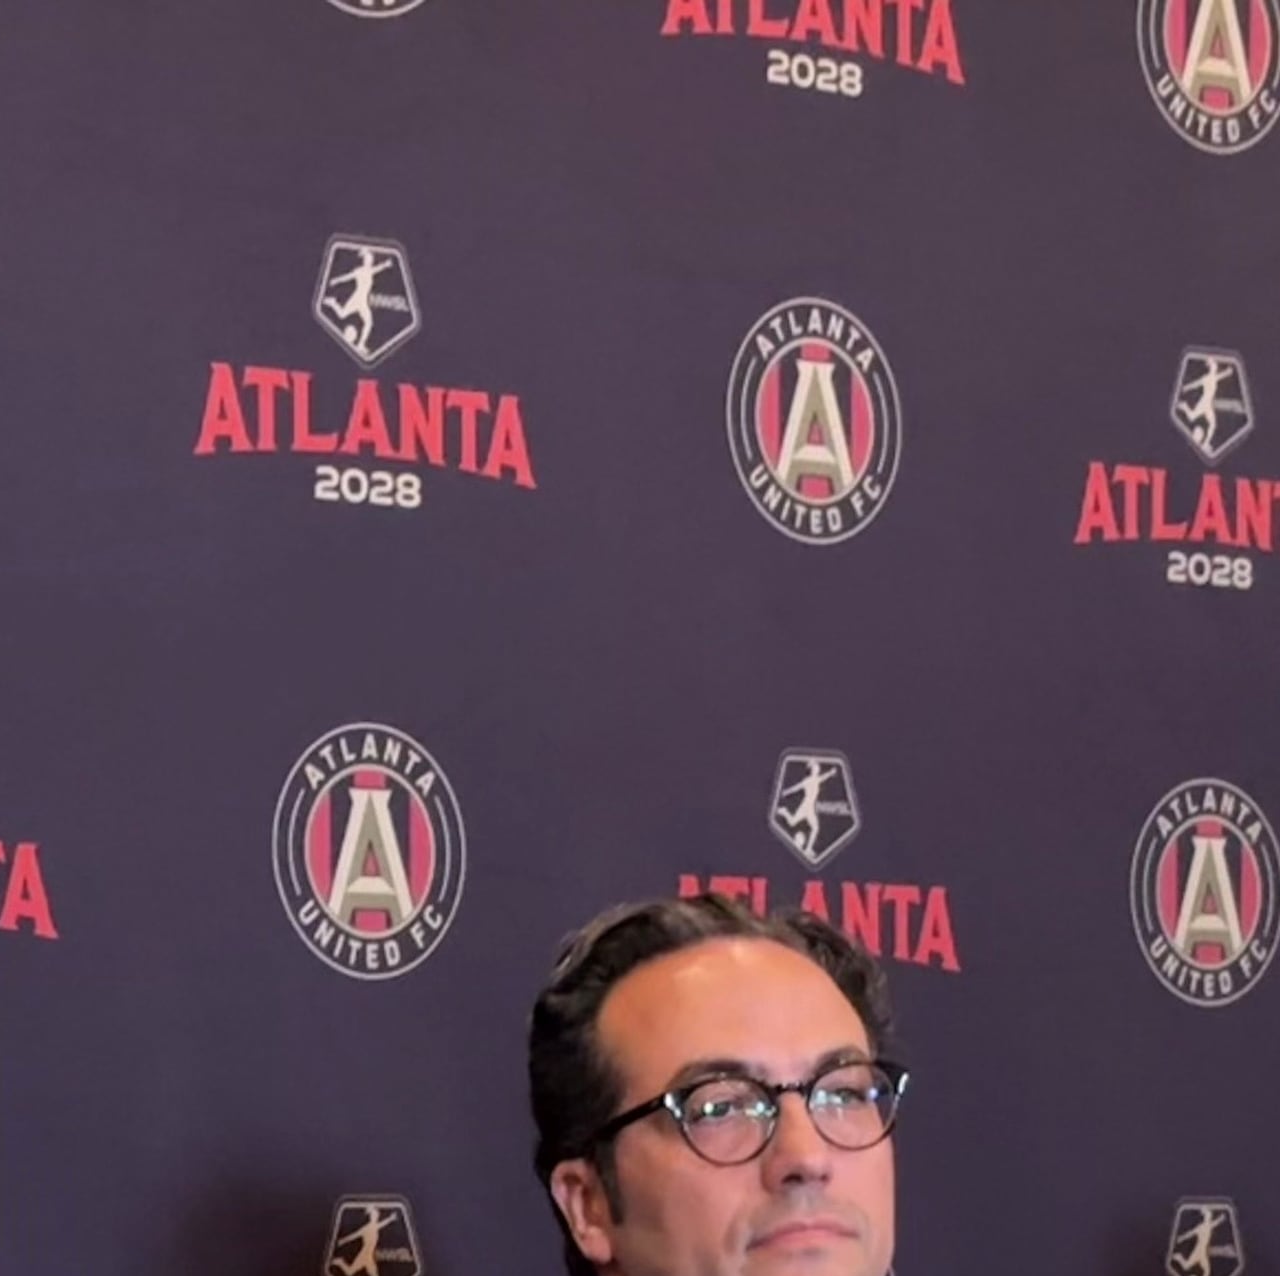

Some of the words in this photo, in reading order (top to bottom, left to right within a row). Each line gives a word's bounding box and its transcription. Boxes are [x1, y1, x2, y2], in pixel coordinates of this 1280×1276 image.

[766, 49, 862, 98] 2028
[1157, 74, 1240, 143] UNITED
[1248, 90, 1277, 129] FC
[755, 308, 874, 372] ATLANTA
[193, 361, 537, 490] ATLANTA
[314, 465, 421, 508] 2028
[749, 464, 843, 534] UNITED
[850, 475, 881, 517] FC
[1166, 550, 1253, 590] 2028
[304, 733, 435, 797] ATLANTA
[1156, 787, 1262, 843] ATLANTA
[298, 899, 401, 969] UNITED
[411, 904, 443, 949] FC
[1150, 936, 1233, 997] UNITED
[1239, 939, 1267, 978] FC
